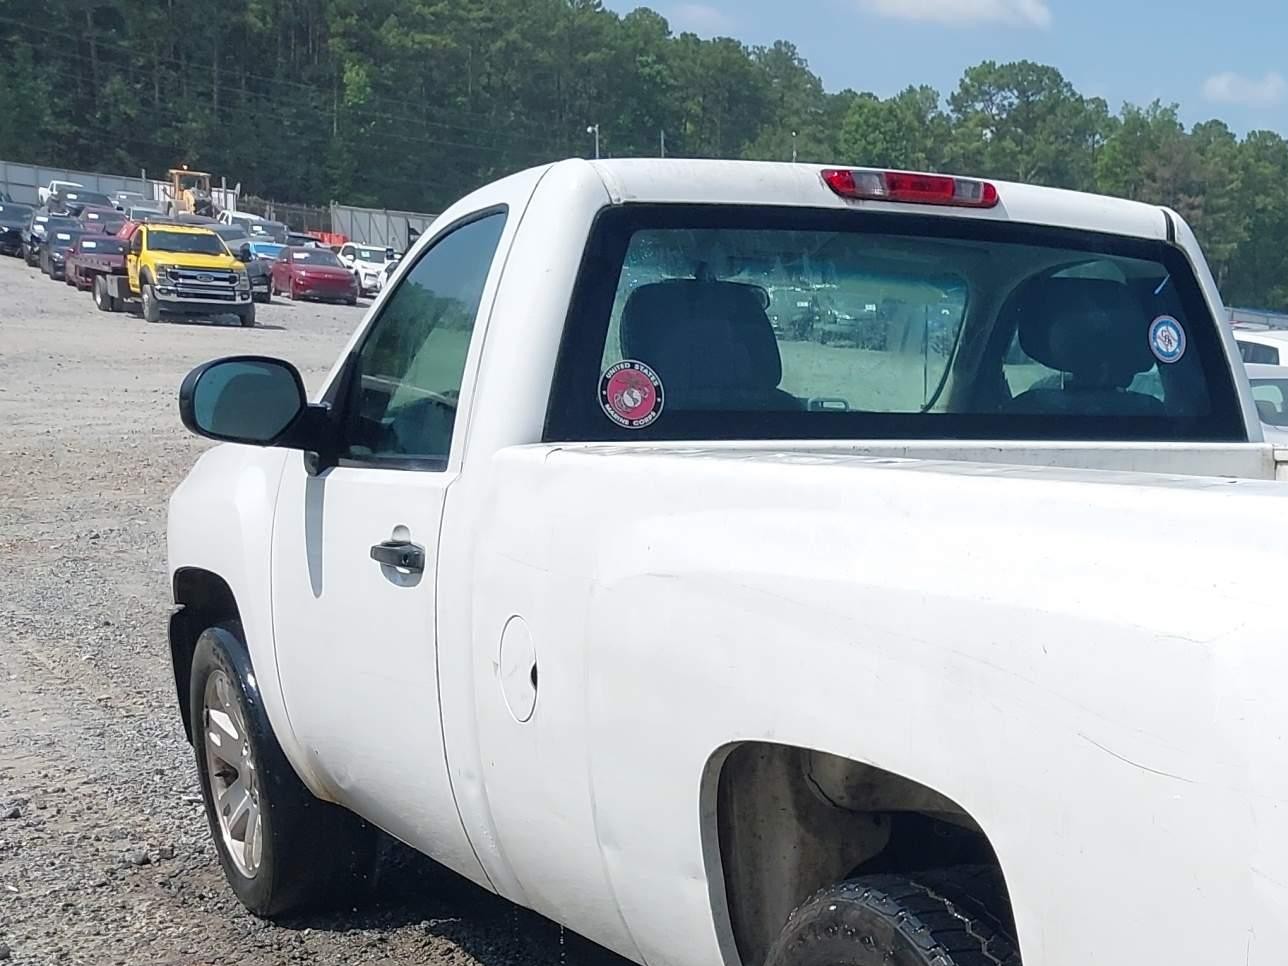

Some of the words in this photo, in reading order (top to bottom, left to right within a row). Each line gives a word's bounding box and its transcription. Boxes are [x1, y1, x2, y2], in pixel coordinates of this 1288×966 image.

[605, 362, 631, 379] UNITED
[634, 364, 659, 387] STATES
[604, 403, 630, 426] MARINE
[632, 411, 657, 426] CORPS
